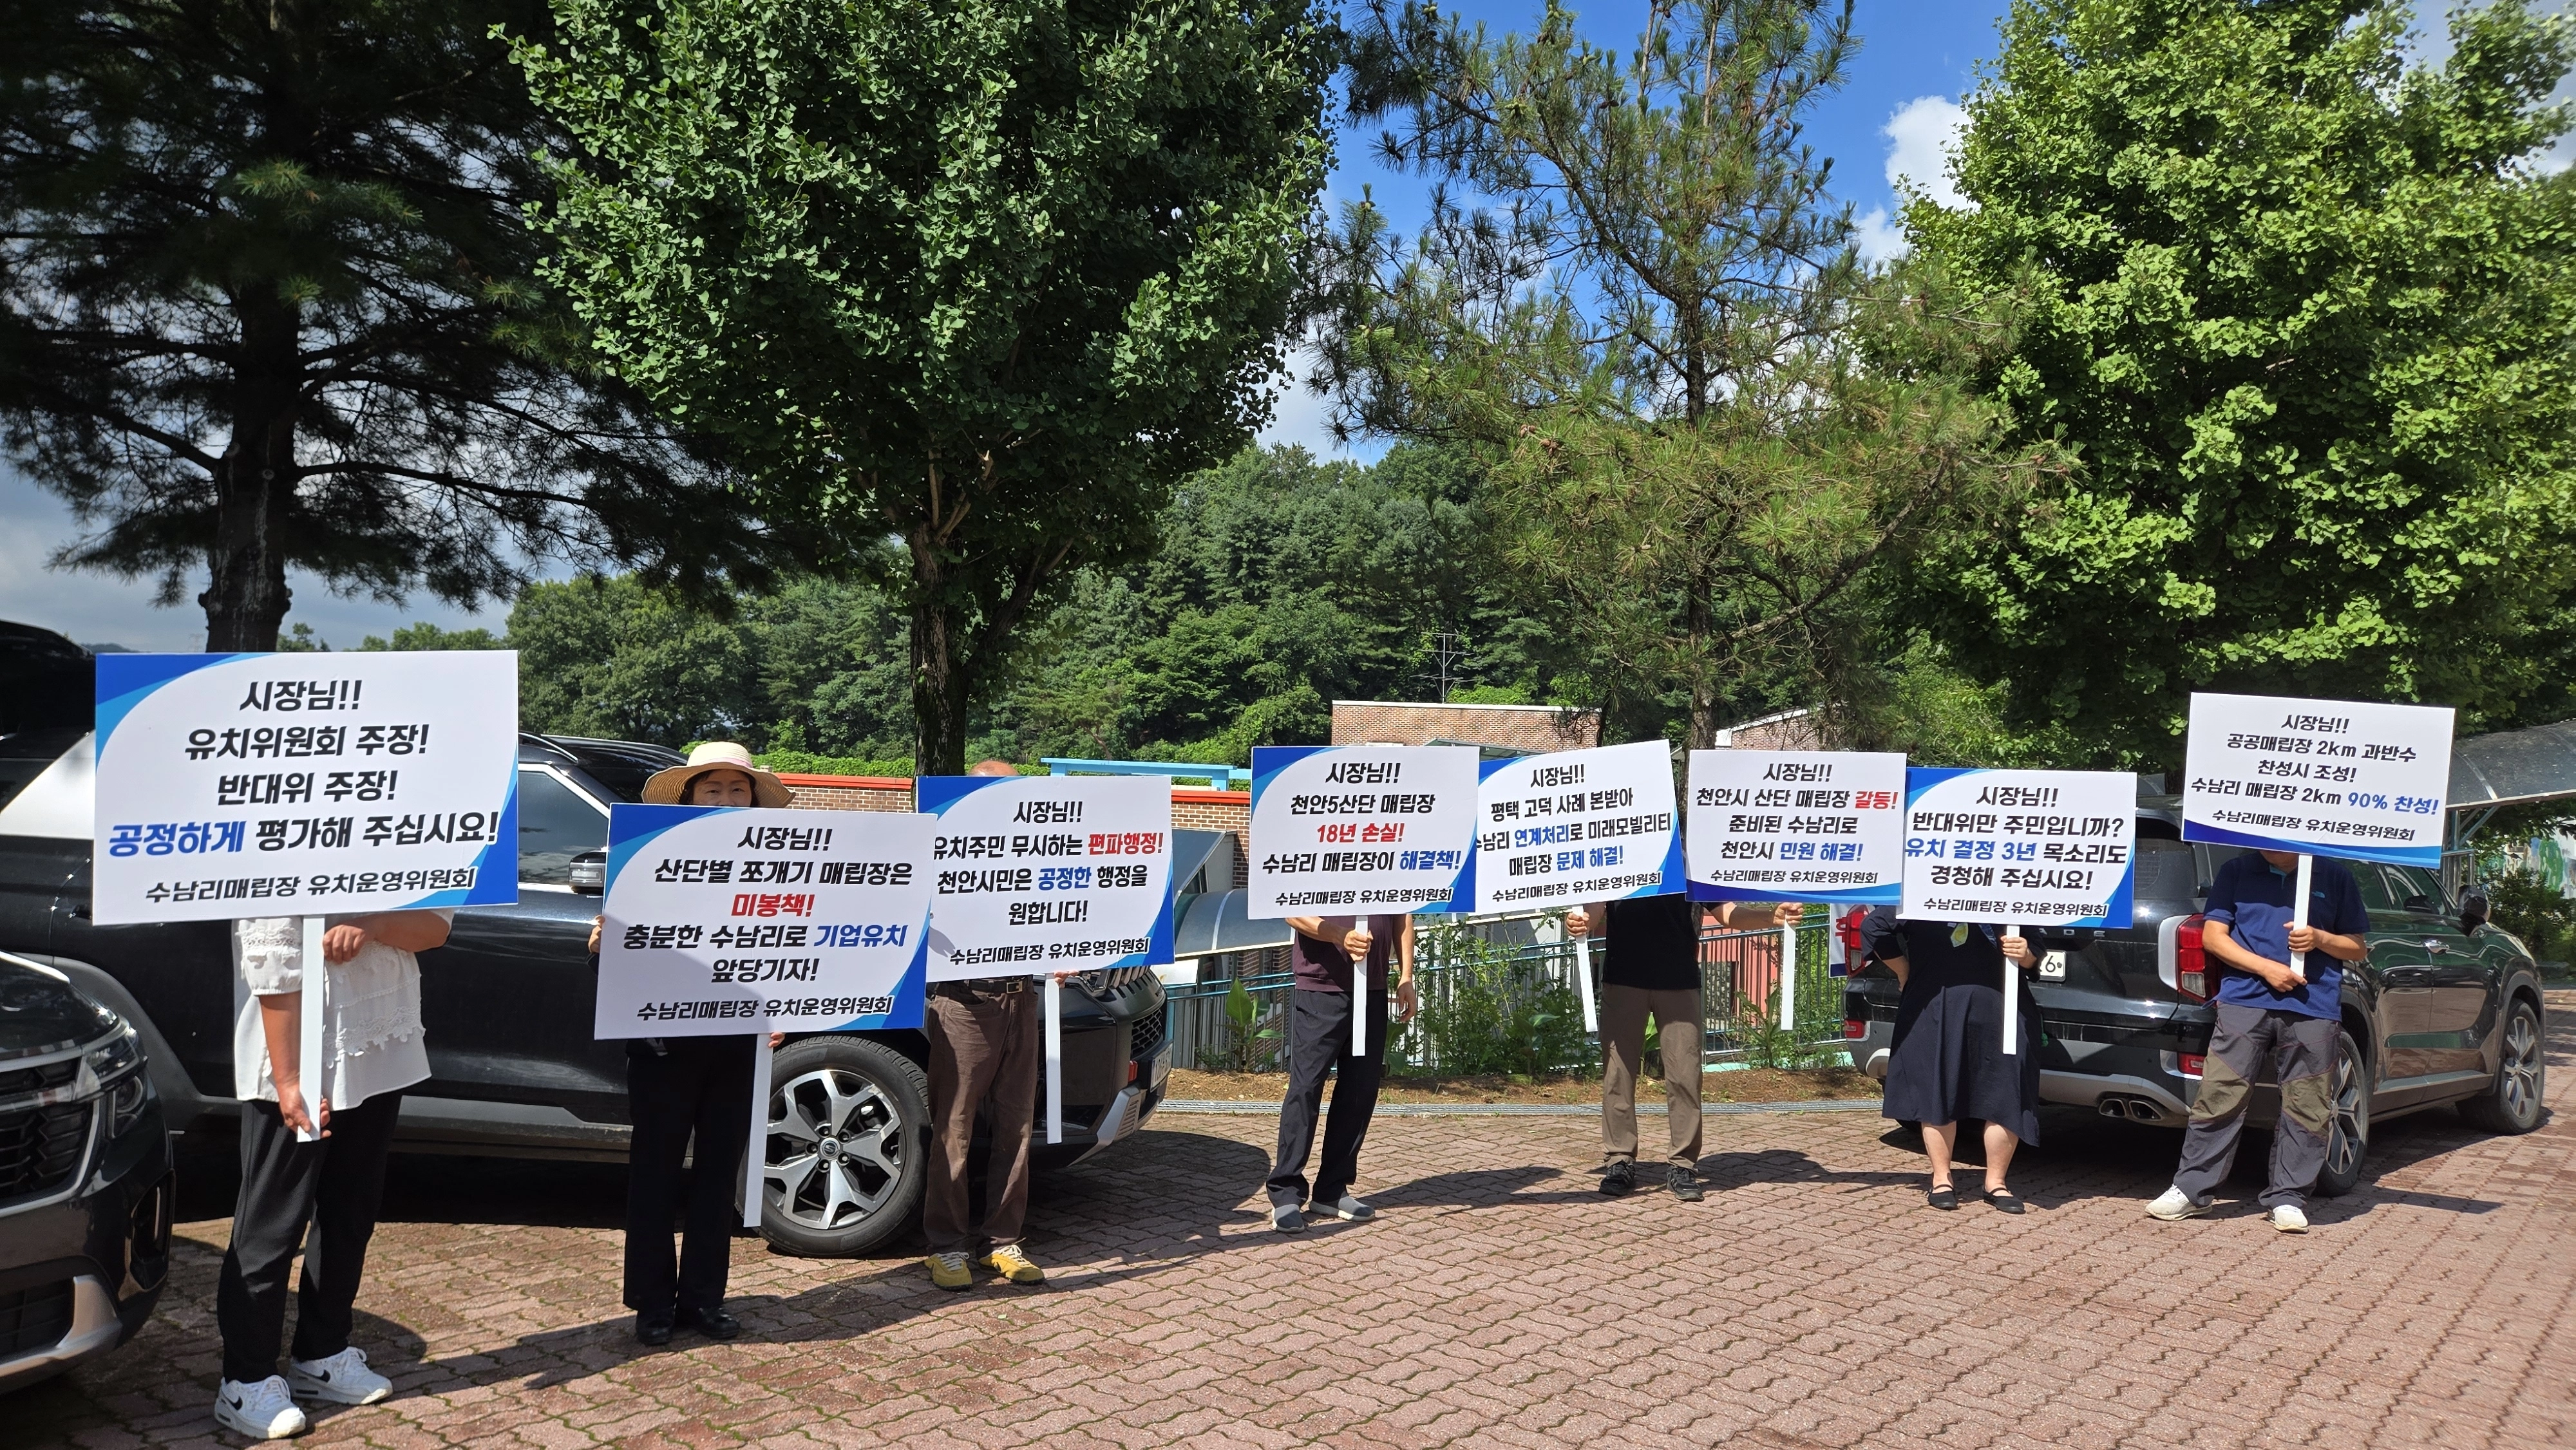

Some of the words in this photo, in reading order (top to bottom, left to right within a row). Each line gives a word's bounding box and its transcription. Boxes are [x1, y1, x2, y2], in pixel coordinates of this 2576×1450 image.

[240, 680, 362, 711] 시장님!!
[2281, 715, 2349, 733] 시장님!!
[185, 726, 346, 760] 유치위원회
[356, 724, 429, 755] 주장!
[2228, 734, 2313, 753] 공공매립장
[2316, 741, 2356, 757] 2km
[2362, 744, 2416, 762] 과반수
[1325, 763, 1401, 784] 시장님!!
[1531, 764, 1584, 787] 시장님!!
[1763, 764, 1832, 782] 시장님!!
[2259, 760, 2309, 778] 찬성시
[2314, 765, 2356, 782] 조성!
[218, 773, 314, 805] 반대위
[324, 771, 397, 802] 주장!
[1697, 788, 1749, 806] 천안시
[1755, 789, 1791, 807] 산단
[1795, 790, 1850, 808] 매립장
[1855, 791, 1898, 809] 갈등!
[1976, 787, 2058, 807] 시장님!!
[2192, 778, 2241, 795] 수남리
[2245, 783, 2298, 800] 매립장
[2302, 788, 2341, 804] 2km
[2349, 793, 2387, 809] 90%
[2394, 796, 2438, 814] 찬성!
[1014, 802, 1083, 823] 시장님!!
[1291, 795, 1376, 814] 천안5산단
[1381, 795, 1435, 813] 매립장
[1492, 801, 1519, 822] 평택
[1525, 797, 1551, 817] 고덕
[1557, 793, 1585, 814] 사례
[1591, 787, 1633, 810] 본받아
[109, 821, 246, 857] 공정하게
[256, 817, 354, 851] 평가해
[363, 812, 498, 846] 주십시요!
[1318, 824, 1356, 842] 18년
[1362, 823, 1405, 842] 손실!
[1515, 824, 1583, 847] 연계처리로
[1589, 813, 1671, 839] 미래모빌리티
[1729, 815, 1783, 833] 준비된
[1788, 816, 1858, 834] 수남리로
[1913, 813, 1997, 833] 반대위만
[2003, 816, 2123, 837] 주민입니까?
[2213, 810, 2302, 829] 수남리매립장
[2306, 820, 2415, 841] 유치운영위원회
[737, 827, 833, 851] 시장님!!
[934, 836, 1006, 860] 유치주민
[1011, 834, 1083, 857] 무시하는
[1088, 833, 1163, 855] 편파행정!
[1721, 841, 1774, 860] 천안시
[1781, 842, 1815, 860] 민원
[1821, 843, 1863, 861] 해결!
[1908, 838, 1946, 858] 유치
[1954, 840, 1995, 860] 결정
[2002, 842, 2036, 861] 3년
[2043, 843, 2126, 863] 목소리도
[655, 859, 734, 883] 산단별
[739, 862, 814, 883] 쪼개기
[819, 862, 912, 885] 매립장은
[1263, 853, 1317, 874] 수남리
[1322, 852, 1395, 872] 매립장이
[1400, 851, 1461, 870] 해결책!
[1510, 854, 1552, 876] 매립장
[1557, 850, 1584, 871] 문제
[1590, 845, 1623, 867] 해결!
[146, 876, 301, 903] 수남리매립장
[308, 869, 475, 895] 유치운영위원회
[938, 869, 1032, 894] 천안시민은
[1038, 867, 1092, 890] 공정한
[1097, 865, 1147, 888] 행정을
[1493, 883, 1568, 901] 수남리매립장
[1573, 872, 1660, 893] 유치운영위원회
[1711, 870, 1786, 882] 수남리매립장
[1790, 871, 1878, 883] 유치운영위원회
[1931, 866, 1994, 886] 경청해
[2000, 869, 2093, 890] 주십시요!
[732, 894, 815, 917] 미봉책!
[1276, 891, 1356, 906] 수남리매립장
[1360, 889, 1452, 903] 유치운영위원회
[1924, 898, 2007, 912] 수남리매립장
[2011, 902, 2107, 916] 유치운영위원회
[1009, 900, 1088, 925] 원합니다!
[623, 925, 703, 950] 충분한
[710, 925, 808, 948] 수남리로
[814, 925, 908, 947] 기업유치
[950, 945, 1045, 965] 수남리매립장
[1048, 938, 1149, 959] 유치운영위원회
[711, 958, 820, 983] 앞당기자!
[637, 999, 759, 1021] 수남리매립장
[763, 997, 893, 1017] 유치운영위원회
